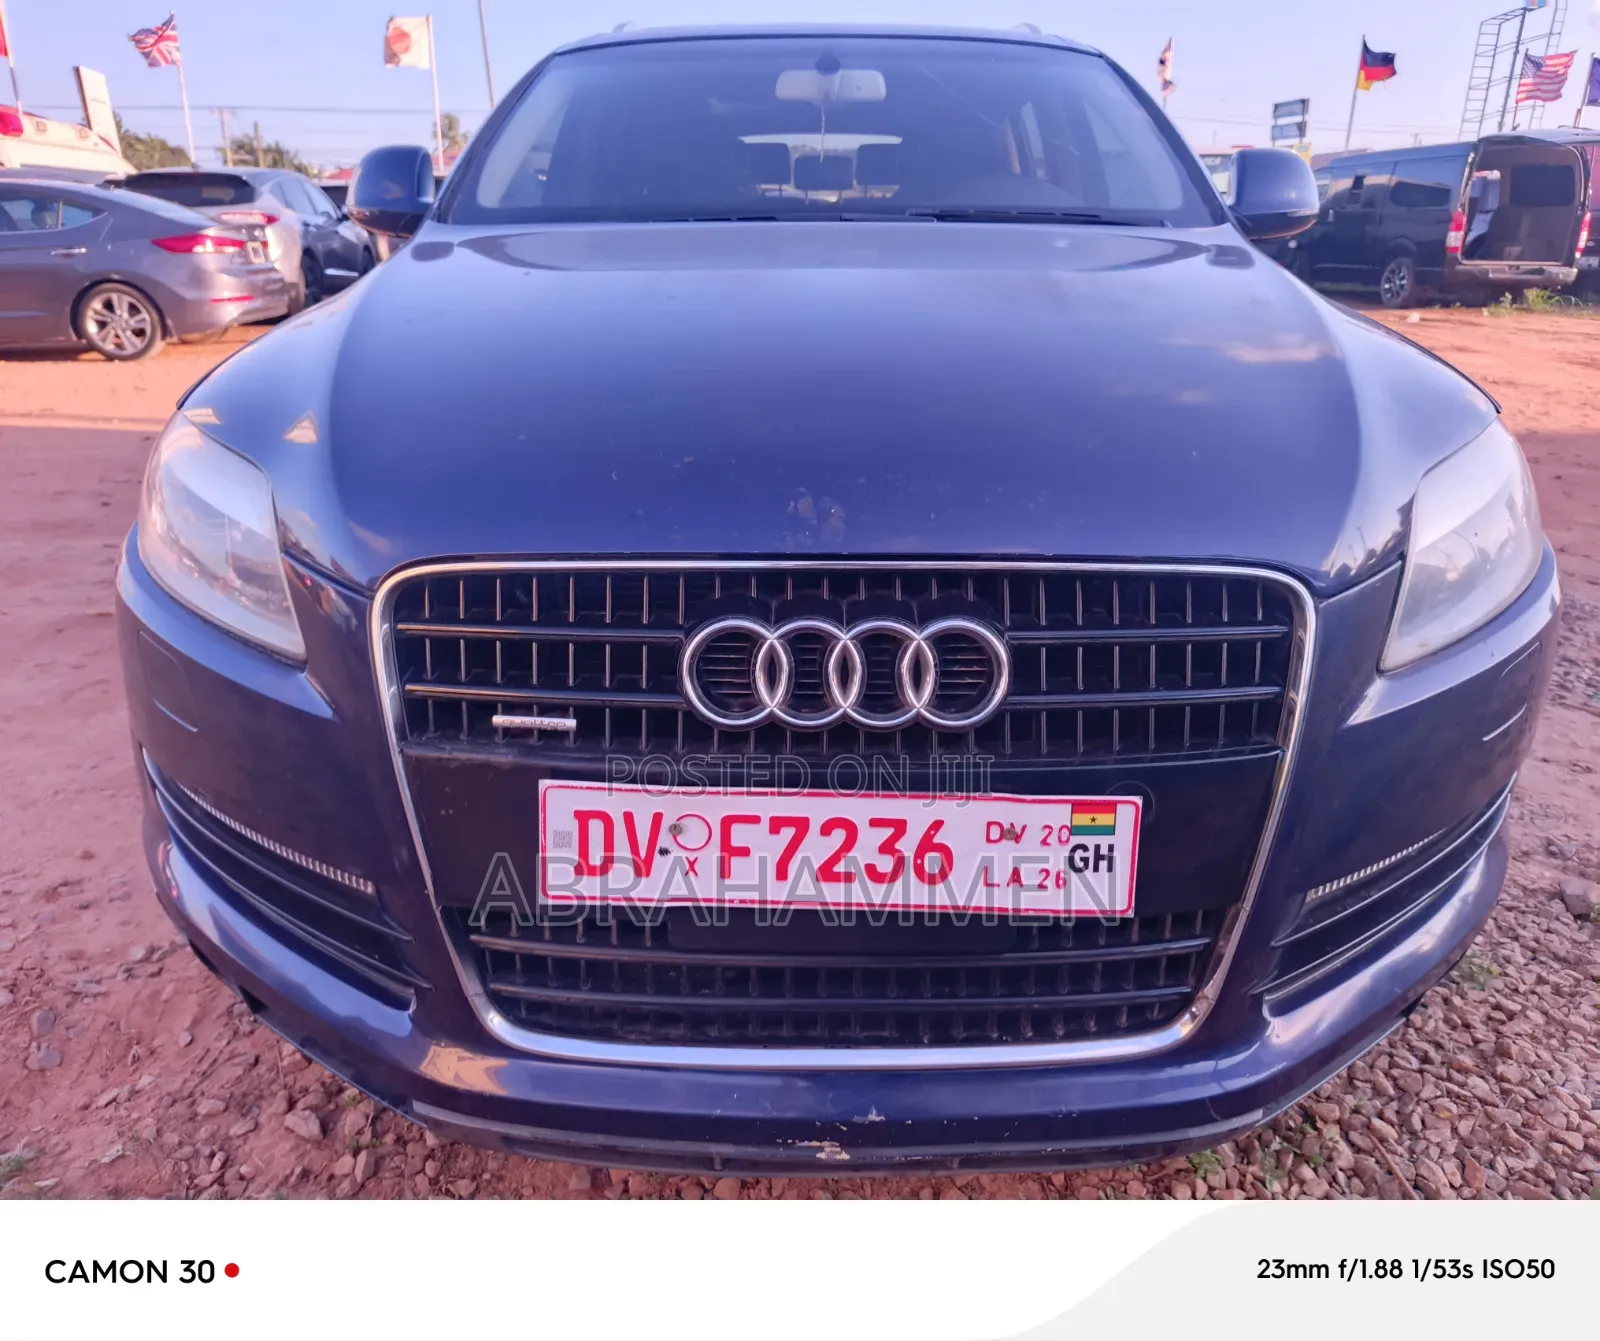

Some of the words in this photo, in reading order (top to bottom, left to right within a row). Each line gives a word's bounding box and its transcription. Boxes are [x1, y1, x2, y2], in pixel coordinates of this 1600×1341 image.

[573, 809, 664, 878] DV
[719, 814, 955, 886] F7236
[985, 820, 1028, 845] DV
[1039, 824, 1072, 847] 20
[1067, 843, 1116, 874] GH
[983, 865, 1024, 889] LA
[1036, 867, 1068, 890] 26
